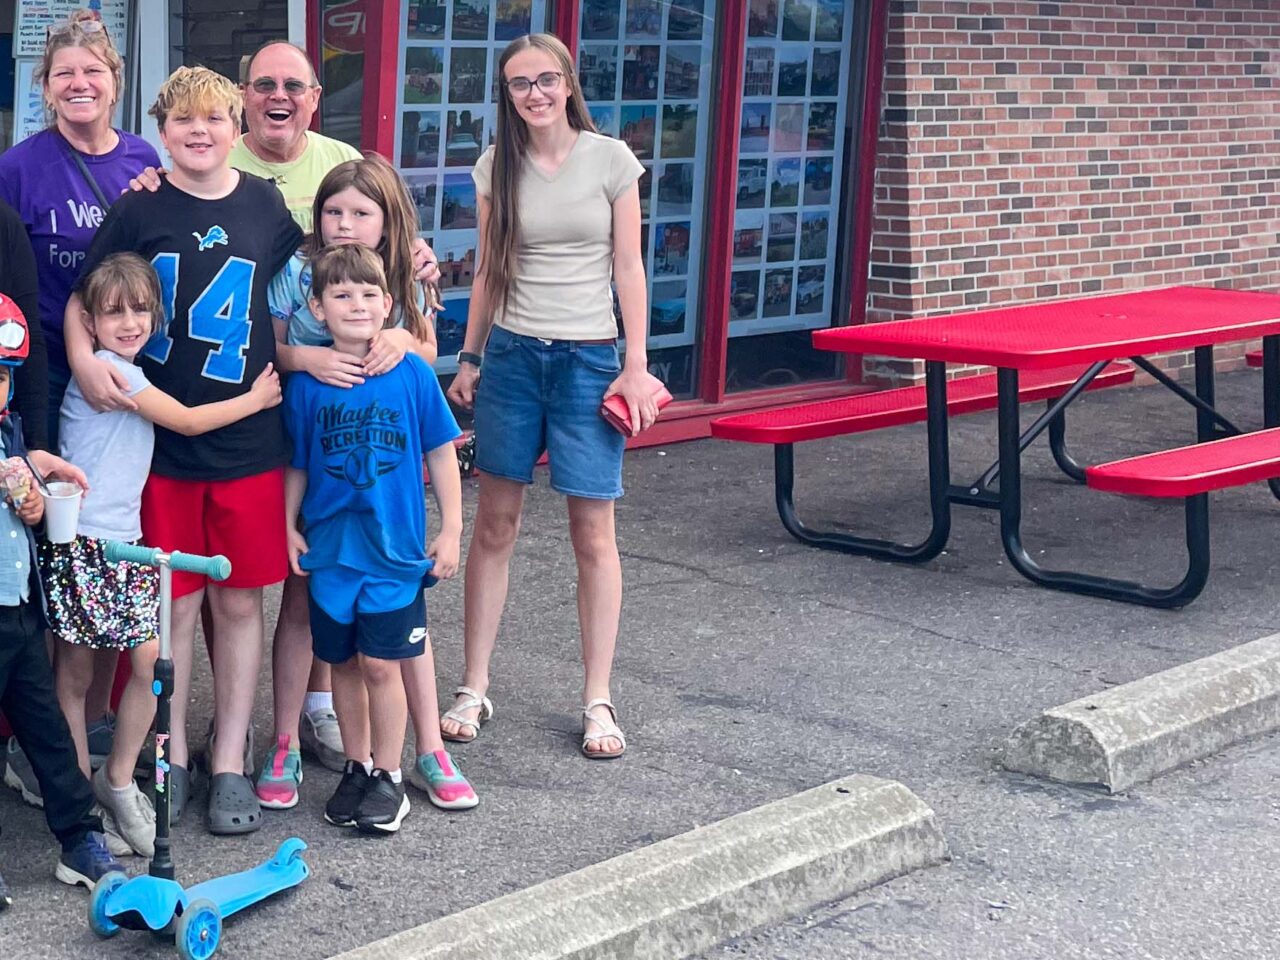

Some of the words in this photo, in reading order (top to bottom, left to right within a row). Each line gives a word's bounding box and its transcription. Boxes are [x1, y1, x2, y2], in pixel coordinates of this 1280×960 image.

[49, 209, 58, 234] I
[66, 198, 108, 230] We
[48, 243, 87, 269] For
[139, 252, 257, 384] 14
[316, 400, 402, 430] Maybee
[319, 427, 408, 453] RECREATION
